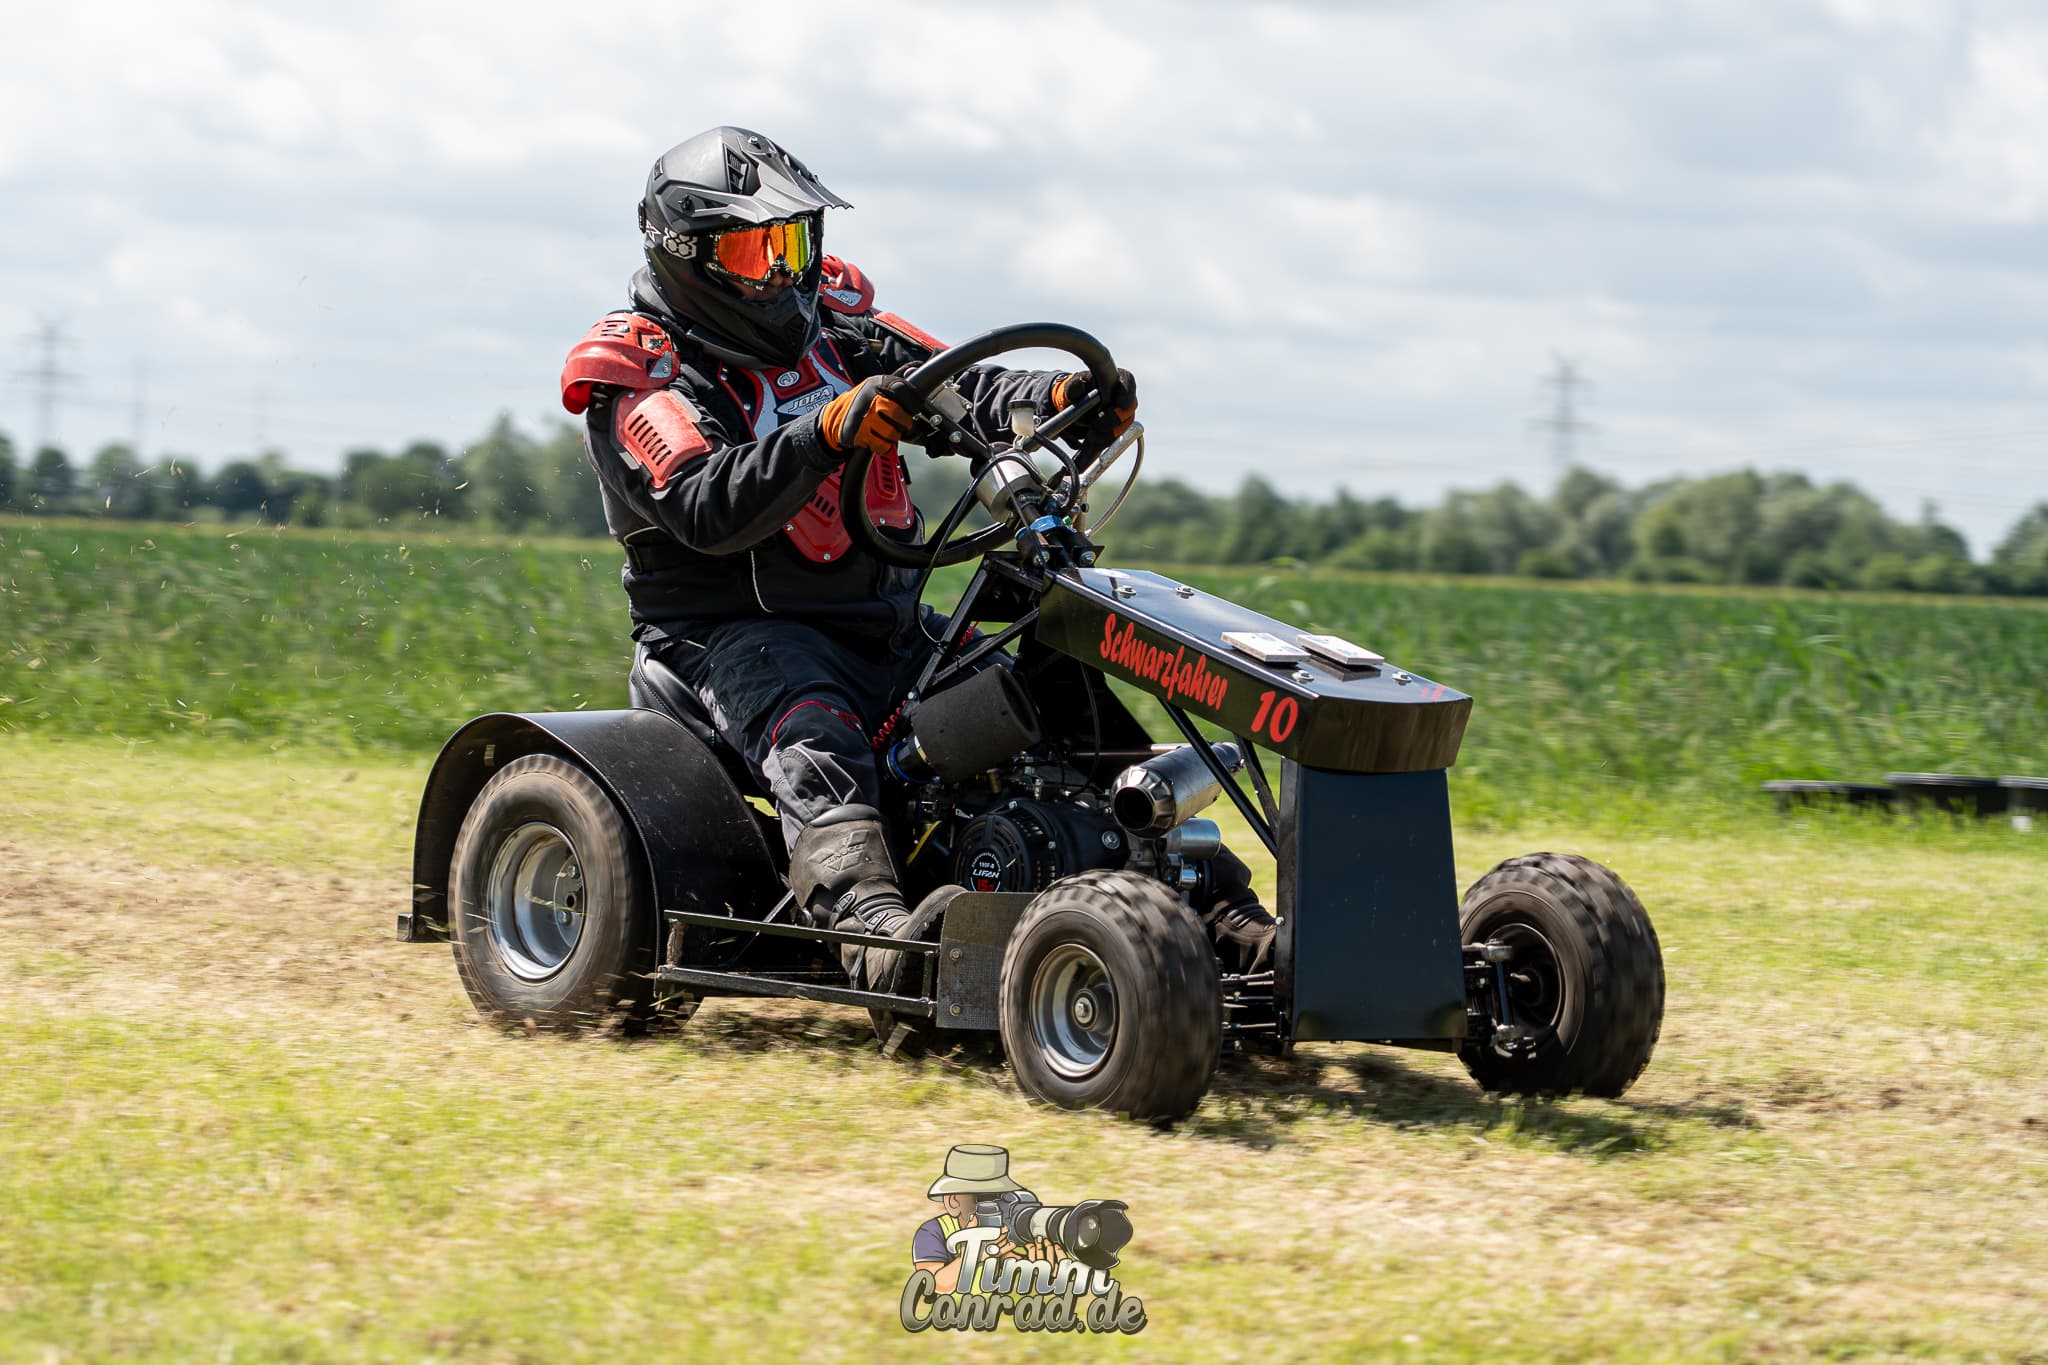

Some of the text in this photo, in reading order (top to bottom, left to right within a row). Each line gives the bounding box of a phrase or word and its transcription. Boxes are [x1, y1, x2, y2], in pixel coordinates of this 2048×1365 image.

[788, 388, 831, 413] JOPA
[1100, 613, 1299, 743] Schwarzfahrer 10
[972, 869, 1000, 878] LIFAN
